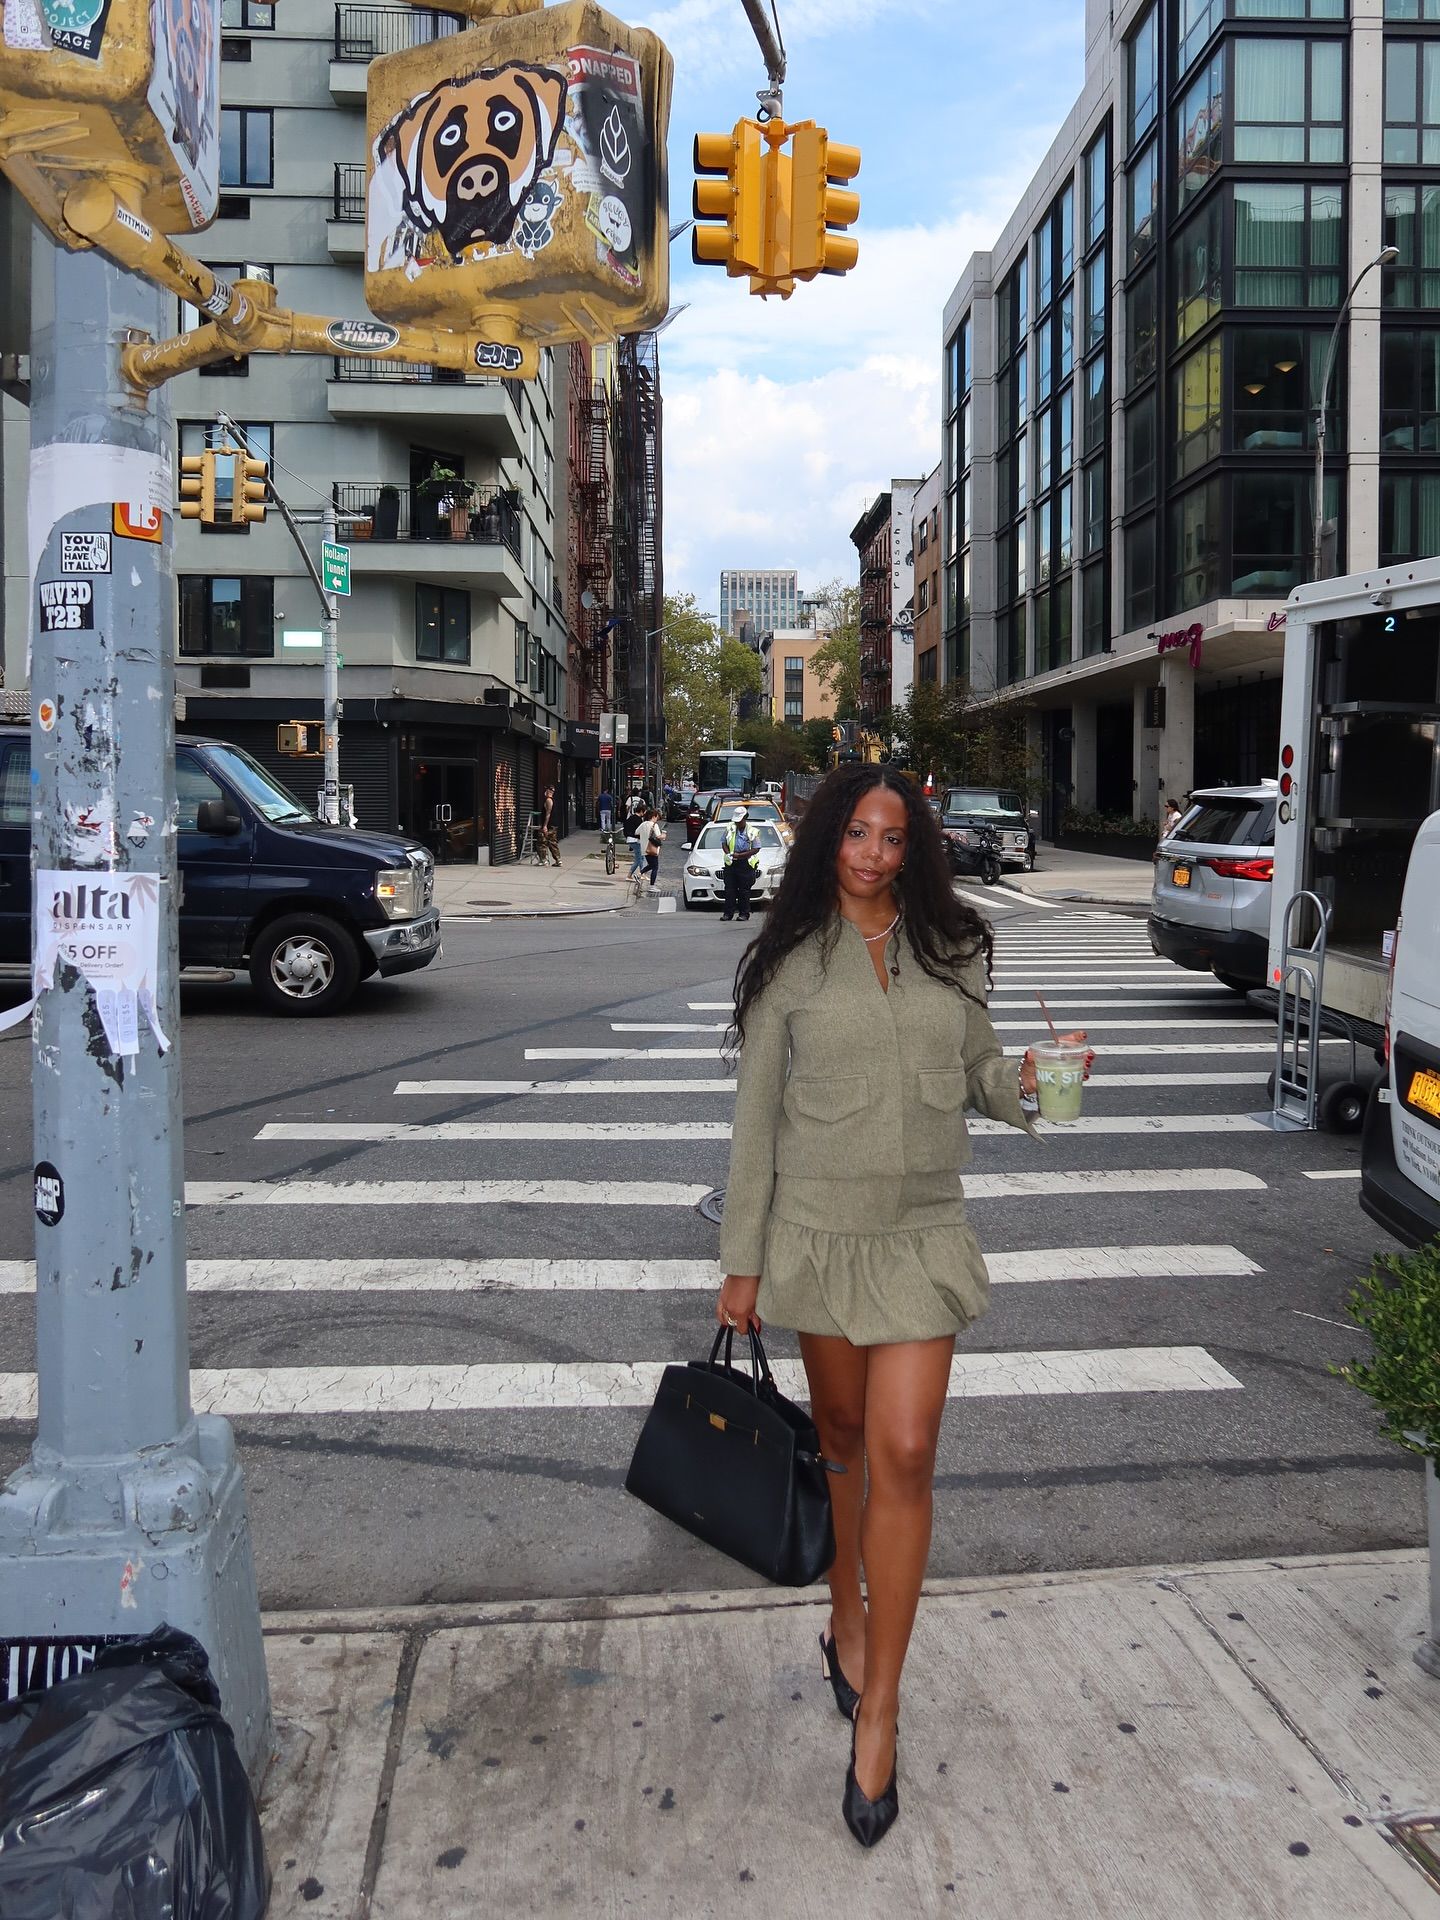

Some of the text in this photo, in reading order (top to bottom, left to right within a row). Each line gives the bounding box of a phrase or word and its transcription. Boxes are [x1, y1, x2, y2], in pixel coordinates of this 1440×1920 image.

[568, 57, 632, 85] DNAPPED
[342, 320, 366, 331] NIC
[343, 330, 391, 344] TIDLER
[64, 535, 95, 545] YOU
[64, 552, 90, 560] HAVE
[324, 545, 348, 563] Holland
[64, 561, 94, 571] IT ALL
[326, 560, 347, 577] Tunnel
[40, 580, 92, 607] WAVED
[45, 605, 82, 630] T2B
[1384, 616, 1395, 632] 2
[53, 885, 131, 919] alta
[53, 922, 131, 931] DISPENSARY
[82, 945, 118, 959] OFF
[1035, 1069, 1082, 1085] NK ST
